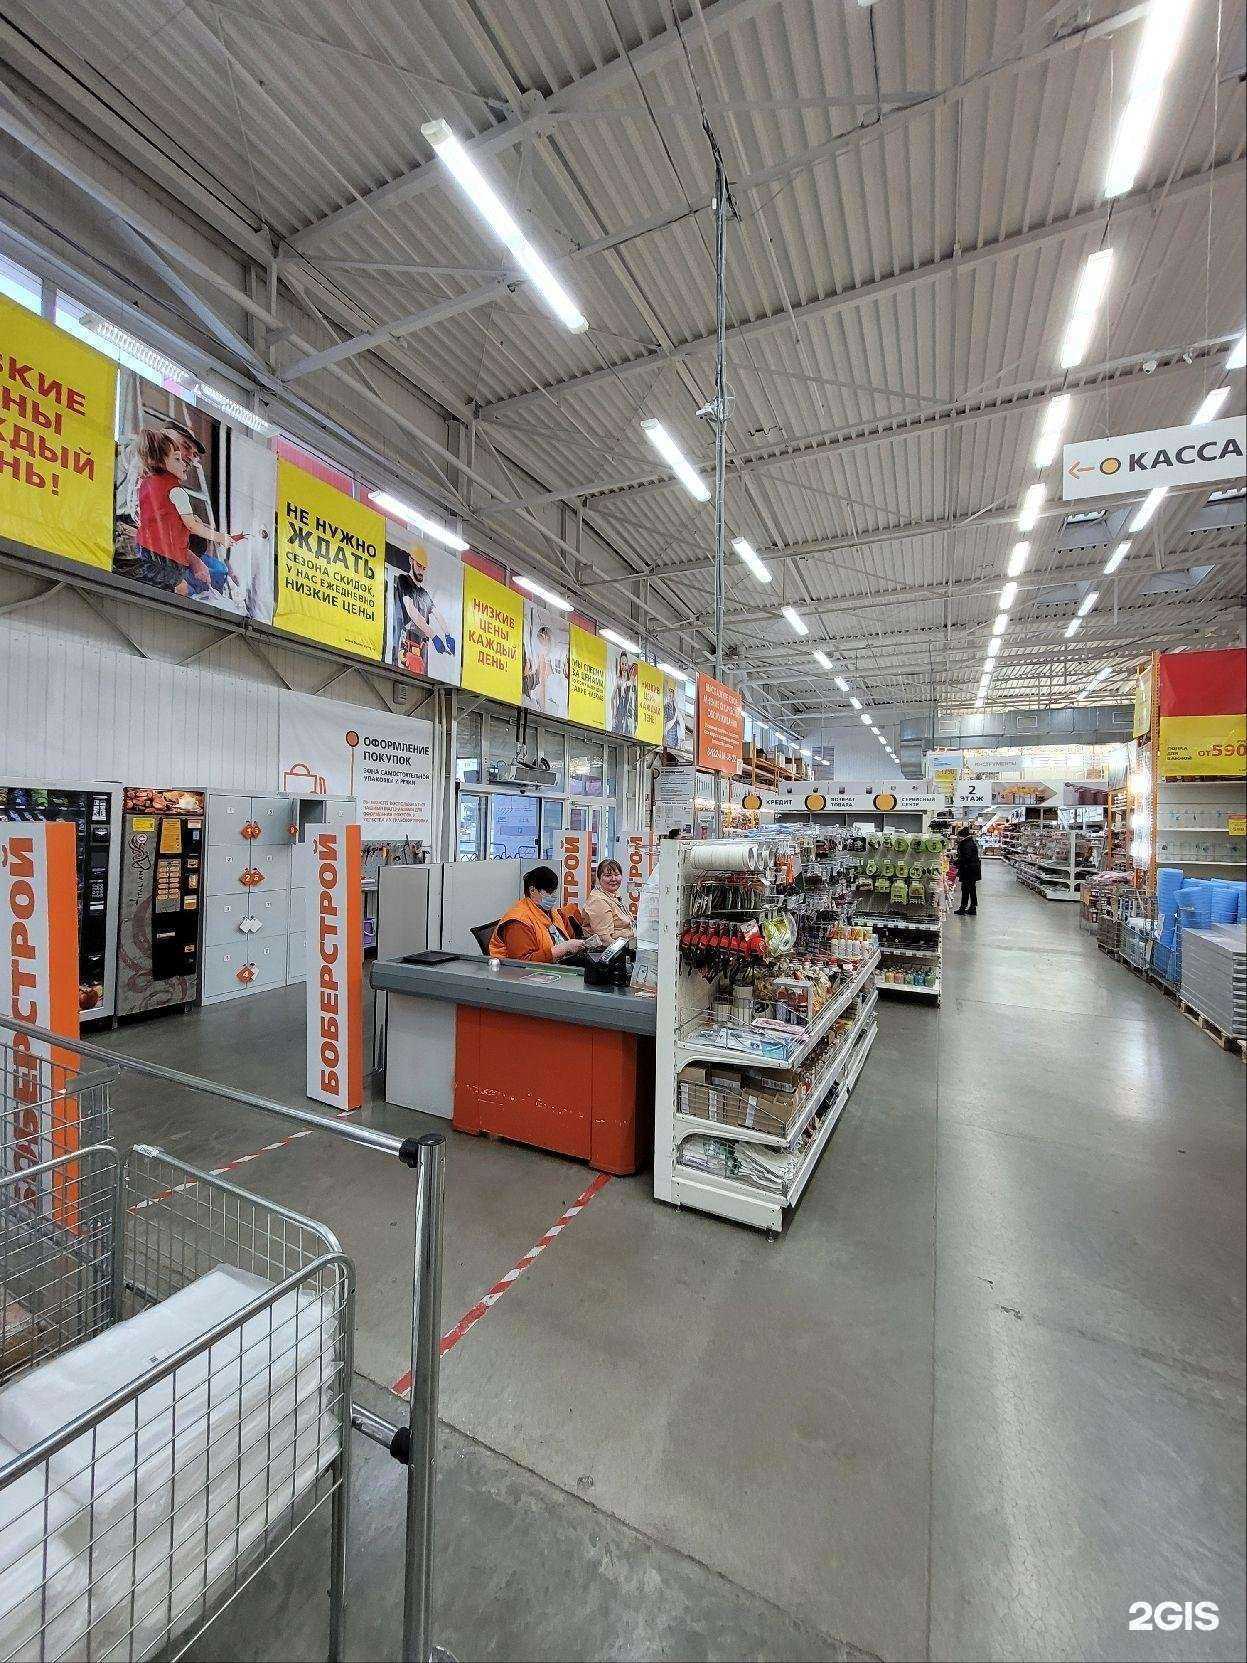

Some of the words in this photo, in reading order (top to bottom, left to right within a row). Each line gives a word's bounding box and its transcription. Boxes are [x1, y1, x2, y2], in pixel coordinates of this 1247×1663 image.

[0, 353, 86, 416] КИЕ
[1129, 438, 1243, 472] КАССА
[286, 501, 310, 526] НЕ
[315, 516, 377, 558] НУЖНО
[286, 551, 330, 577] СЕЗОНА
[287, 521, 375, 580] ЖДАТЬ
[285, 576, 339, 608] НИЗКИЕ
[342, 604, 375, 622] ЦЕНЫ
[286, 564, 293, 574] У
[296, 569, 318, 584] НАС
[320, 578, 375, 608] ЕЖЕДНЕВНО
[473, 598, 515, 630] НИЗКИЕ
[479, 618, 509, 641] ЦЕНЫ
[468, 630, 517, 661] КАЖДЫЙ
[477, 651, 508, 673] ДЕНЬ!
[363, 737, 430, 755] ОФОРМЛЕНИЕ
[363, 751, 412, 766] ПОКУПОК
[968, 785, 977, 795] 2
[313, 833, 340, 1096] БОБЕРСТРОЙ
